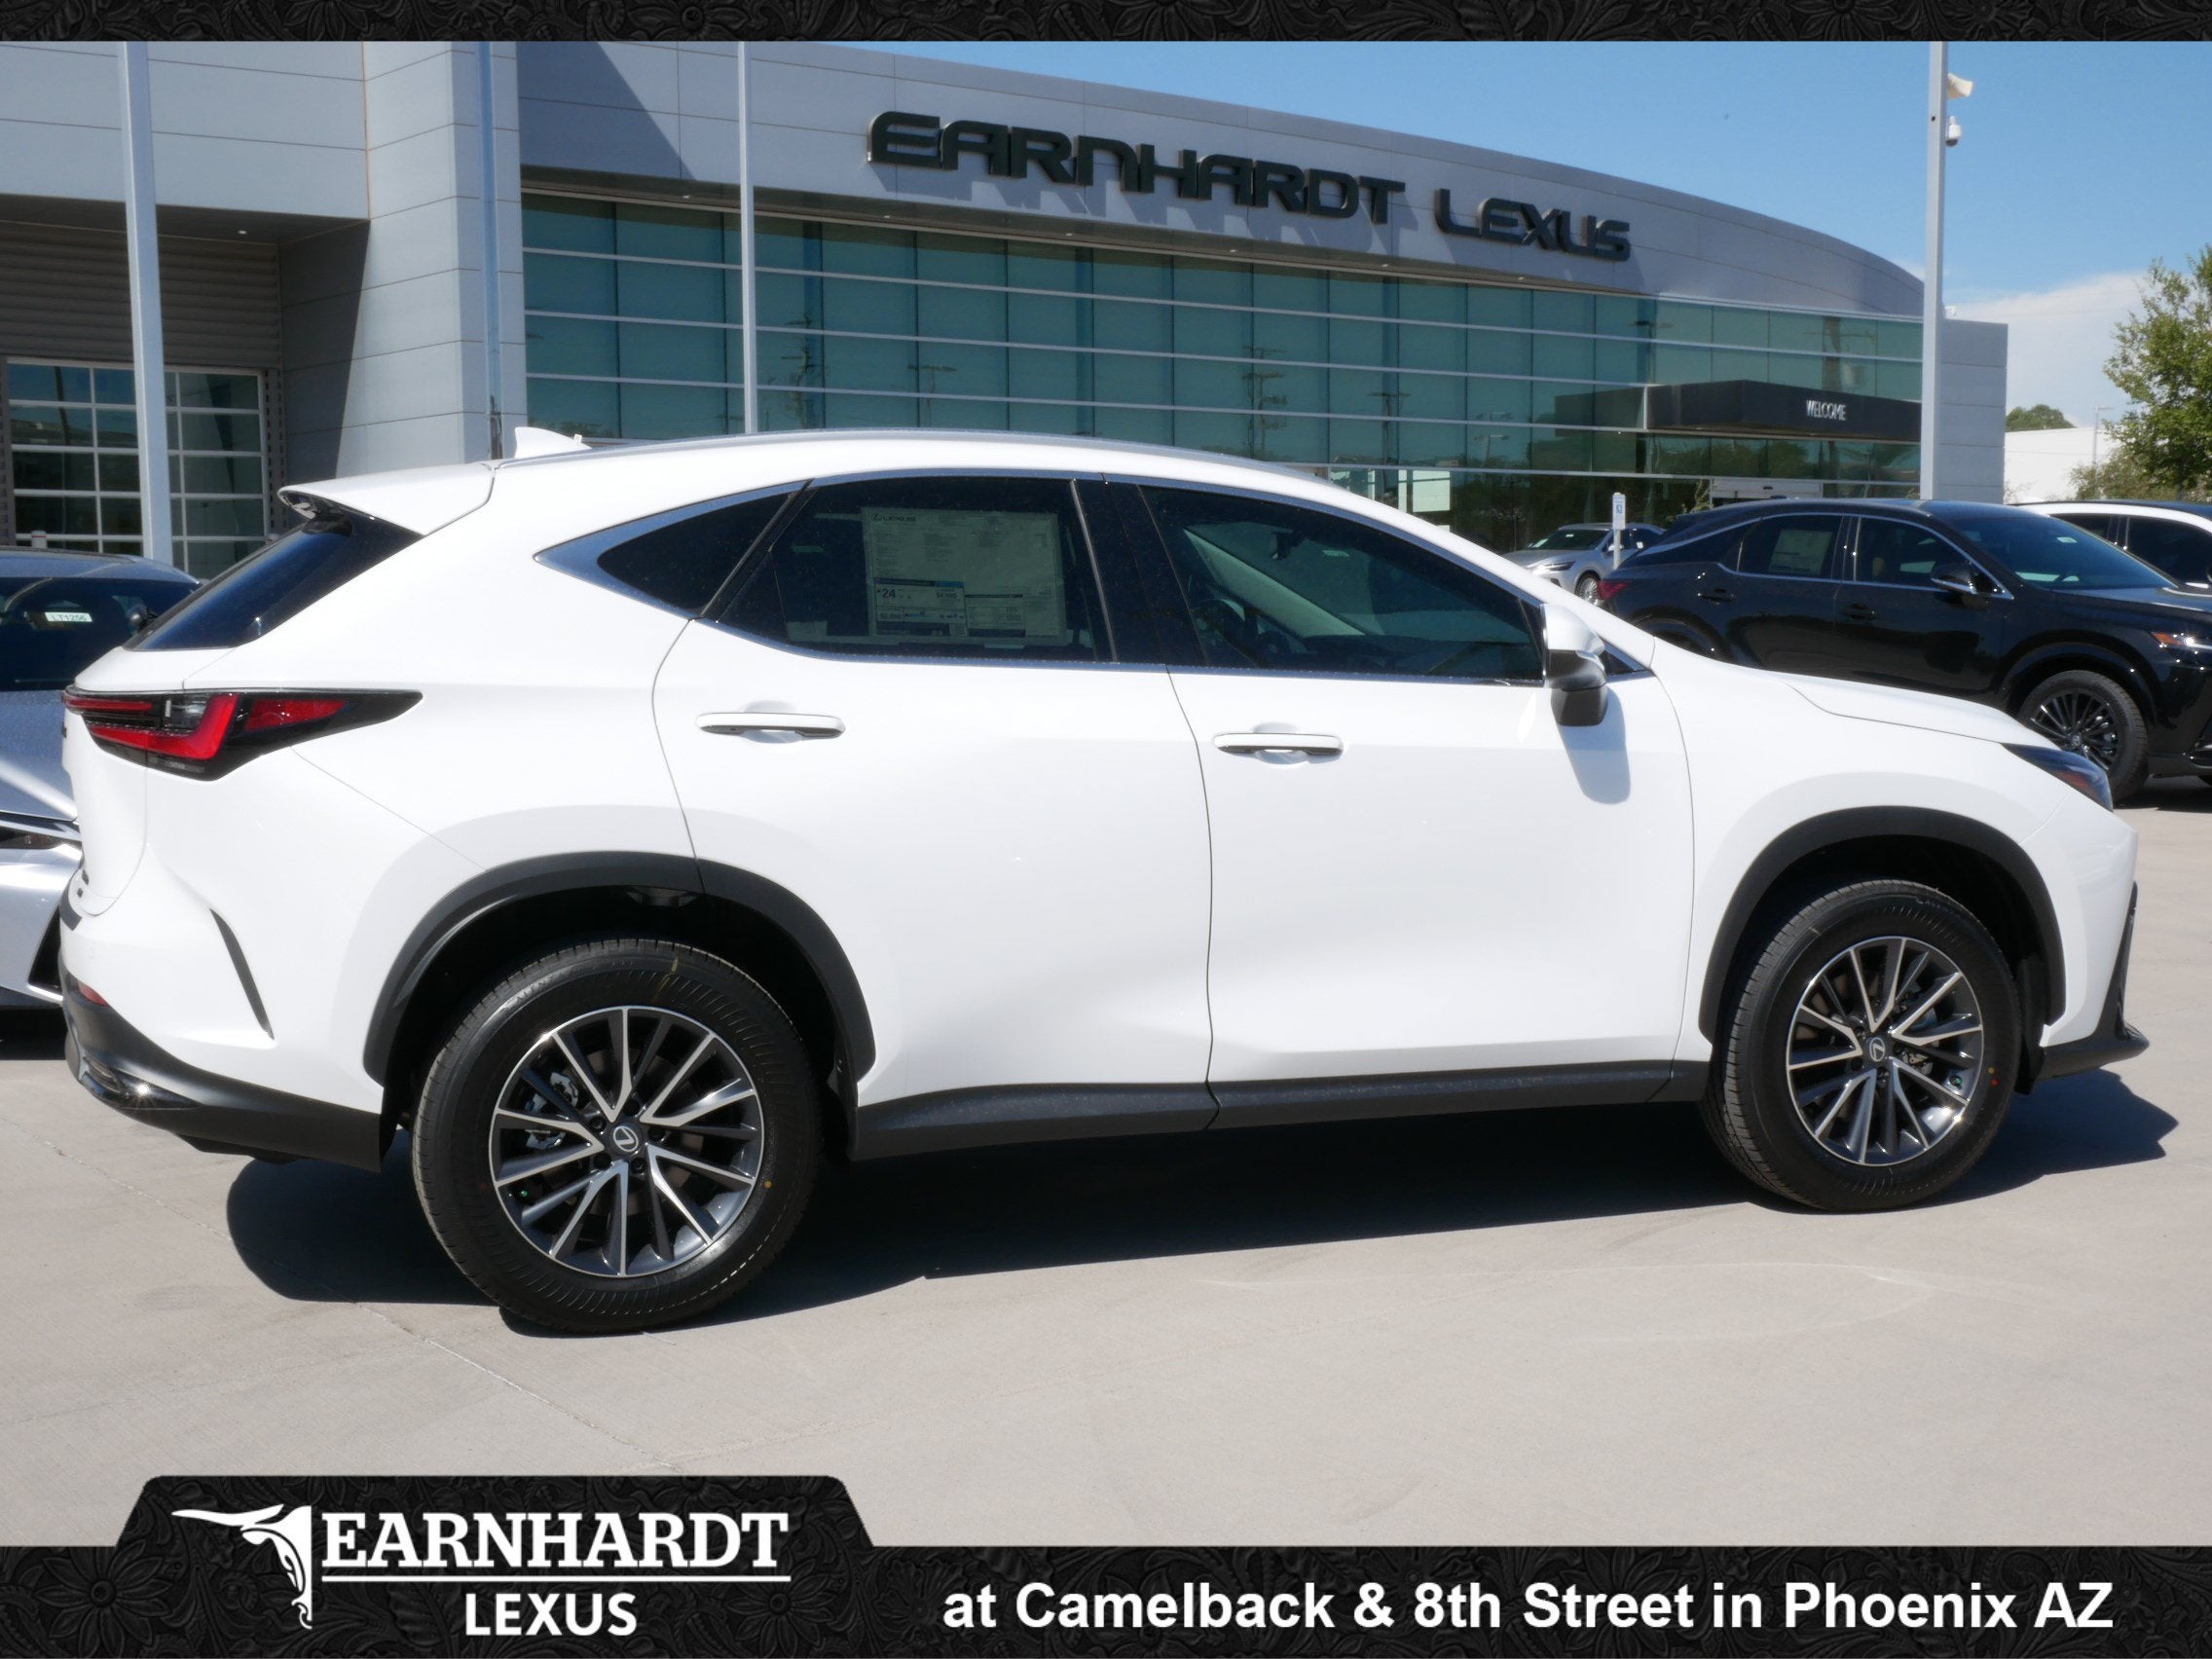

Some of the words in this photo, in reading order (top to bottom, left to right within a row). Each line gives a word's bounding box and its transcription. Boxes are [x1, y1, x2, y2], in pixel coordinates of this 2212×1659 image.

[867, 111, 1405, 225] EARNHARDT
[1435, 187, 1632, 262] LEXUS
[1806, 399, 1846, 421] WELCOME
